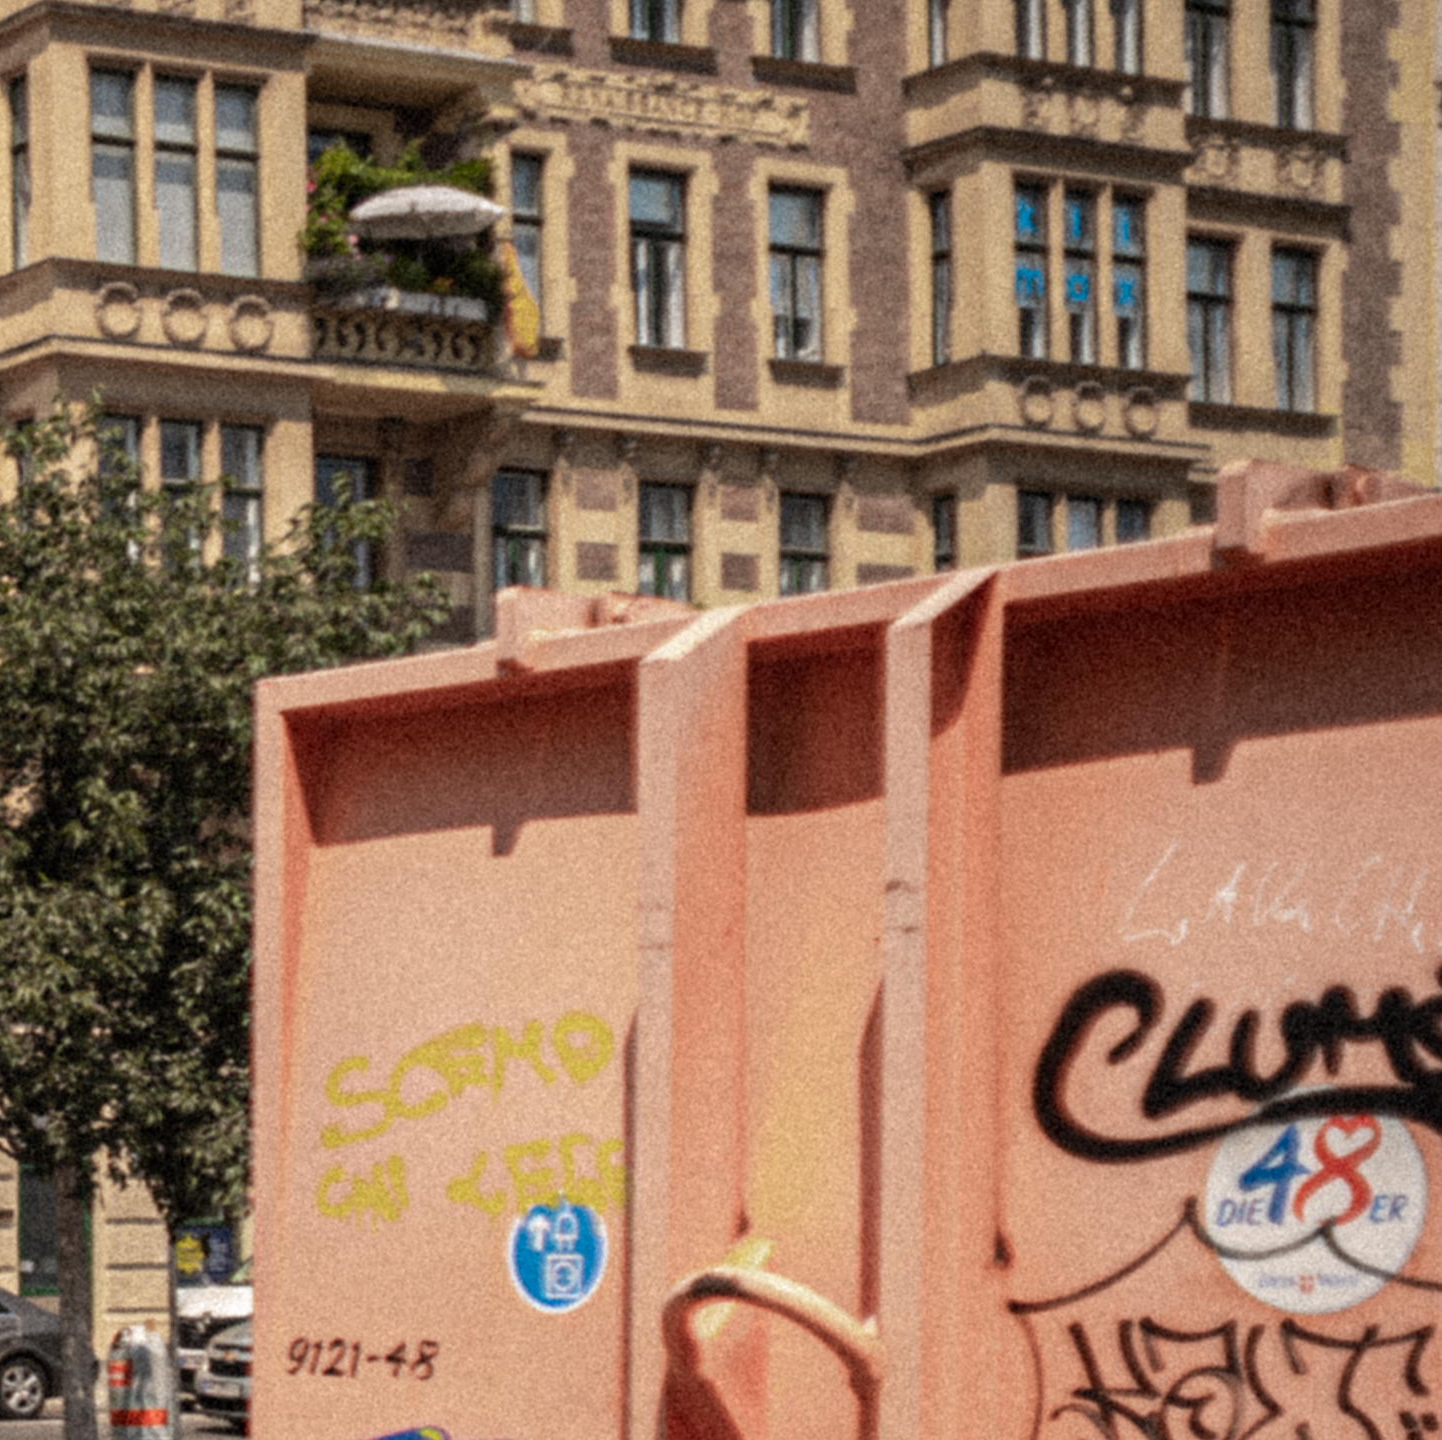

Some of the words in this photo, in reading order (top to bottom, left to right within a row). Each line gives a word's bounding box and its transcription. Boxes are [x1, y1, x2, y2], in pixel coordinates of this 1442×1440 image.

[1216, 1197, 1266, 1228] DIE
[1368, 1193, 1410, 1223] ER
[287, 1337, 440, 1381] 9121-48
